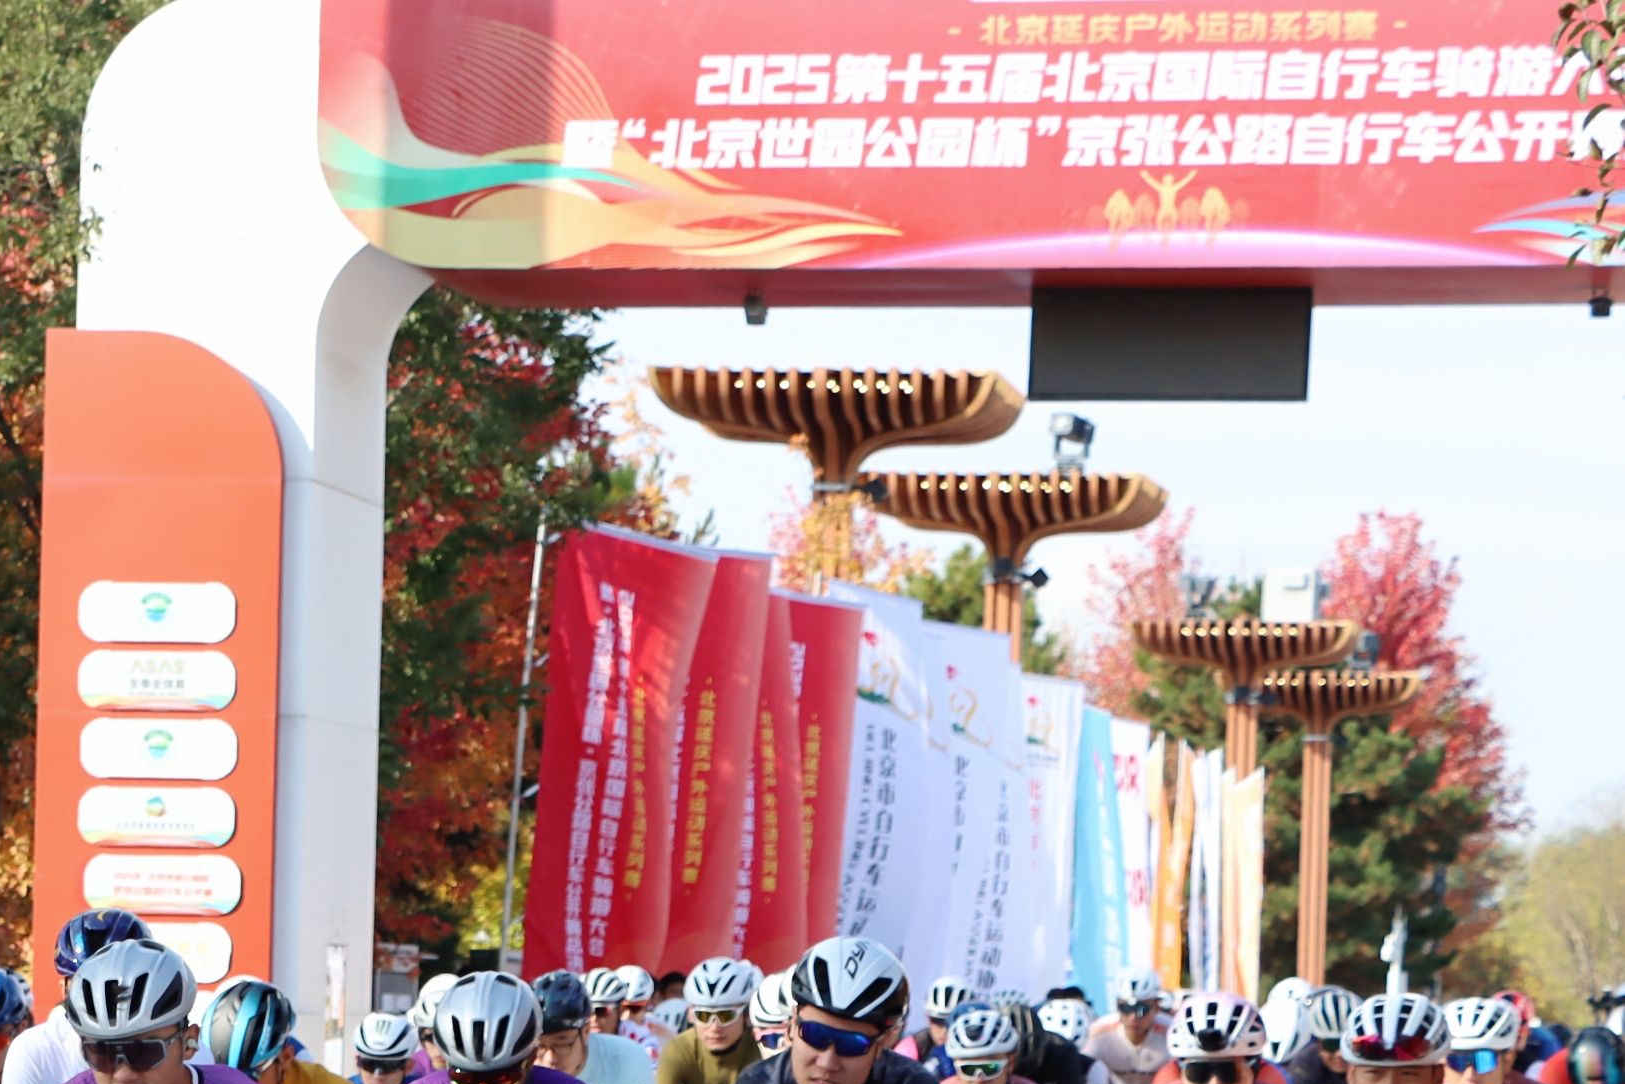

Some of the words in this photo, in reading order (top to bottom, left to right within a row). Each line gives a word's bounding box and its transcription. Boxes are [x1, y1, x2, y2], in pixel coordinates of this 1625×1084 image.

[979, 11, 1380, 46] 北京延庆户外运动系列赛
